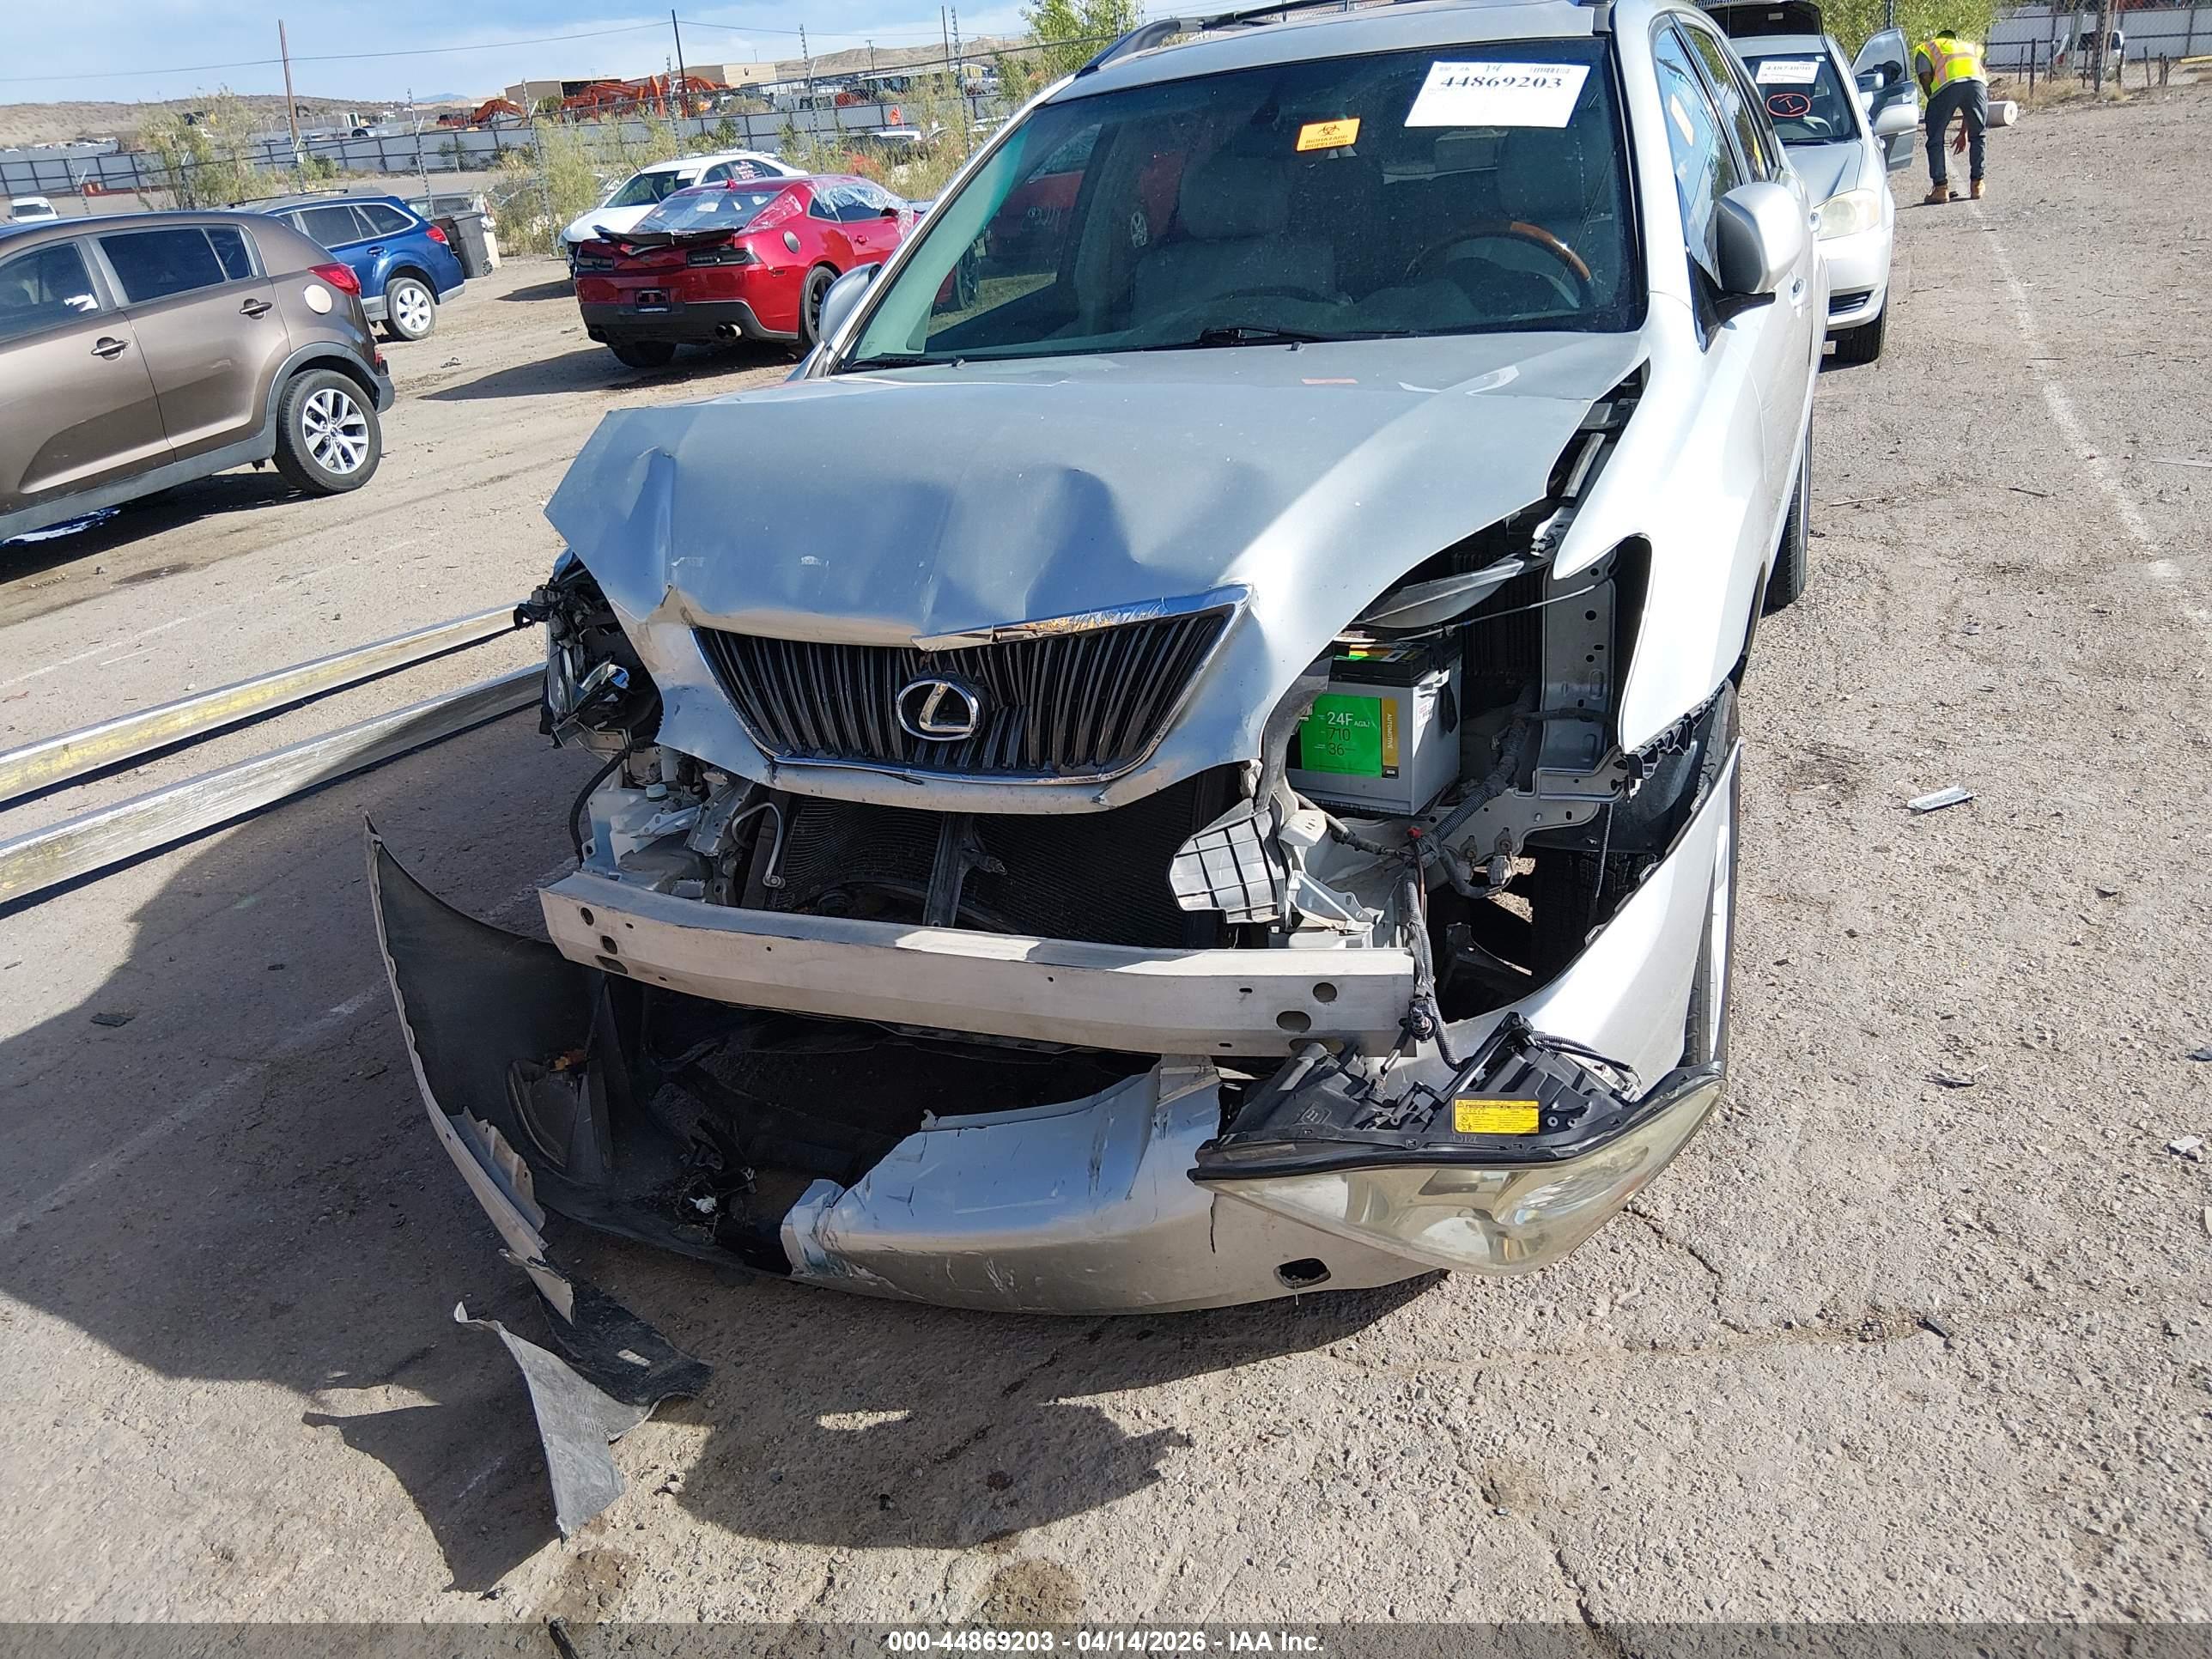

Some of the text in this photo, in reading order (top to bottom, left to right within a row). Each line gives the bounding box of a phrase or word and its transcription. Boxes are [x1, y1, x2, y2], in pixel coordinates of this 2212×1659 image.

[1440, 76, 1563, 88] 44869203
[1327, 711, 1354, 726] 24F
[1328, 727, 1351, 741] 710
[1328, 742, 1345, 756] 36
